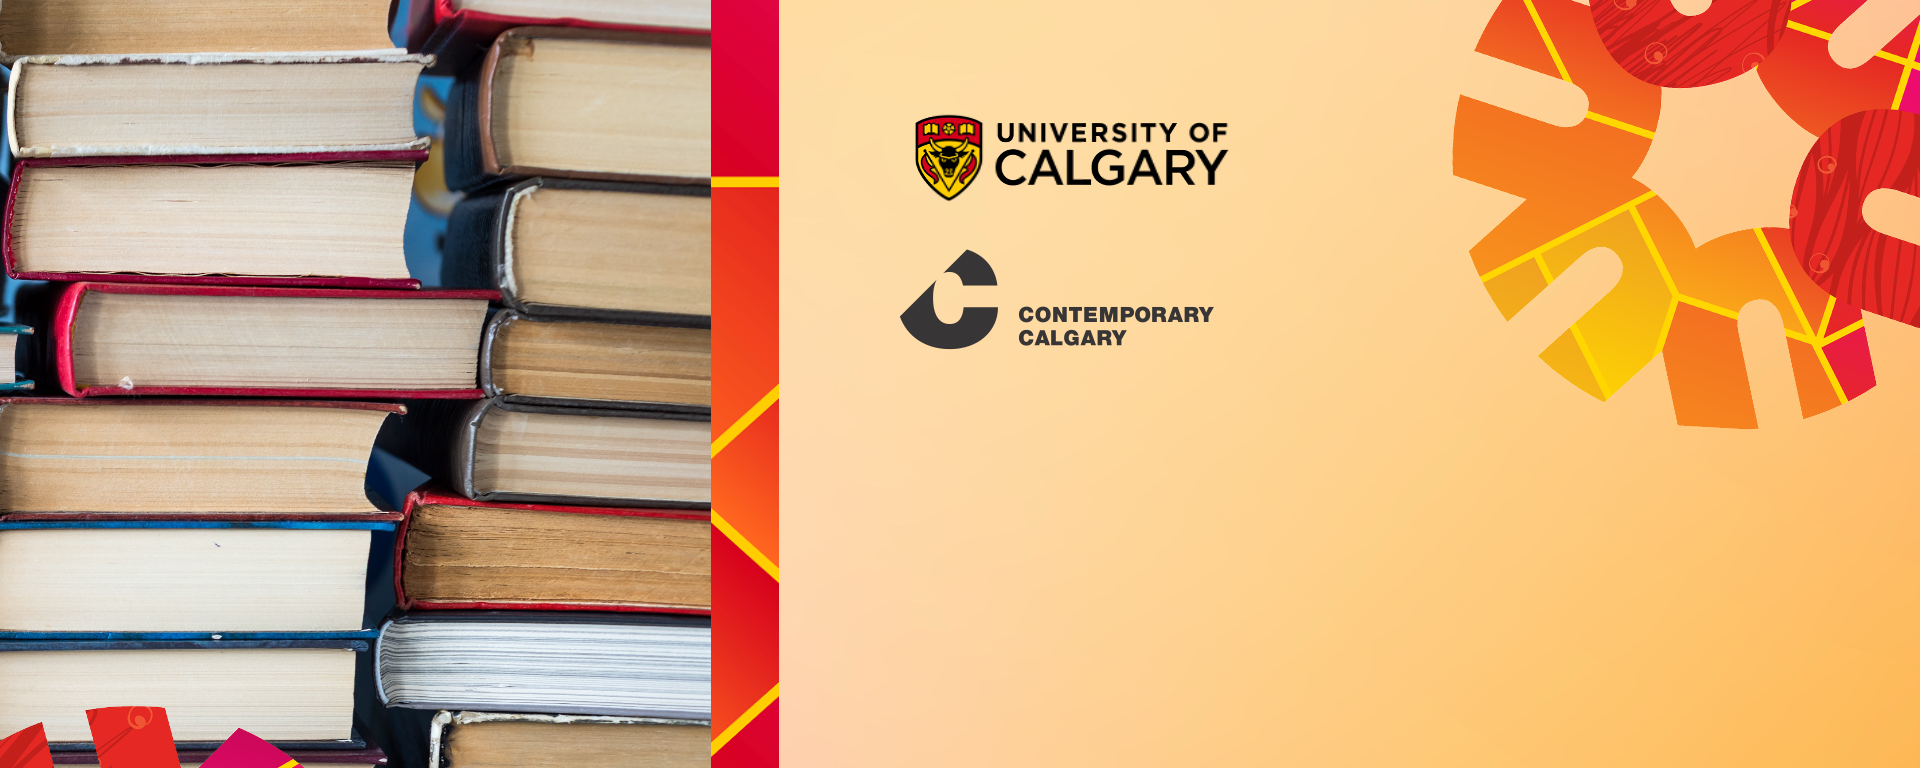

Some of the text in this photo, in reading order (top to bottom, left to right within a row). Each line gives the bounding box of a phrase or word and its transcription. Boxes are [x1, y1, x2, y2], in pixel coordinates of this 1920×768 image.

[997, 122, 1228, 143] UNIVERSITY OF
[995, 148, 1229, 186] CALGARY
[1018, 306, 1214, 323] CONTEMPORARY
[1018, 329, 1127, 346] CALGARY
